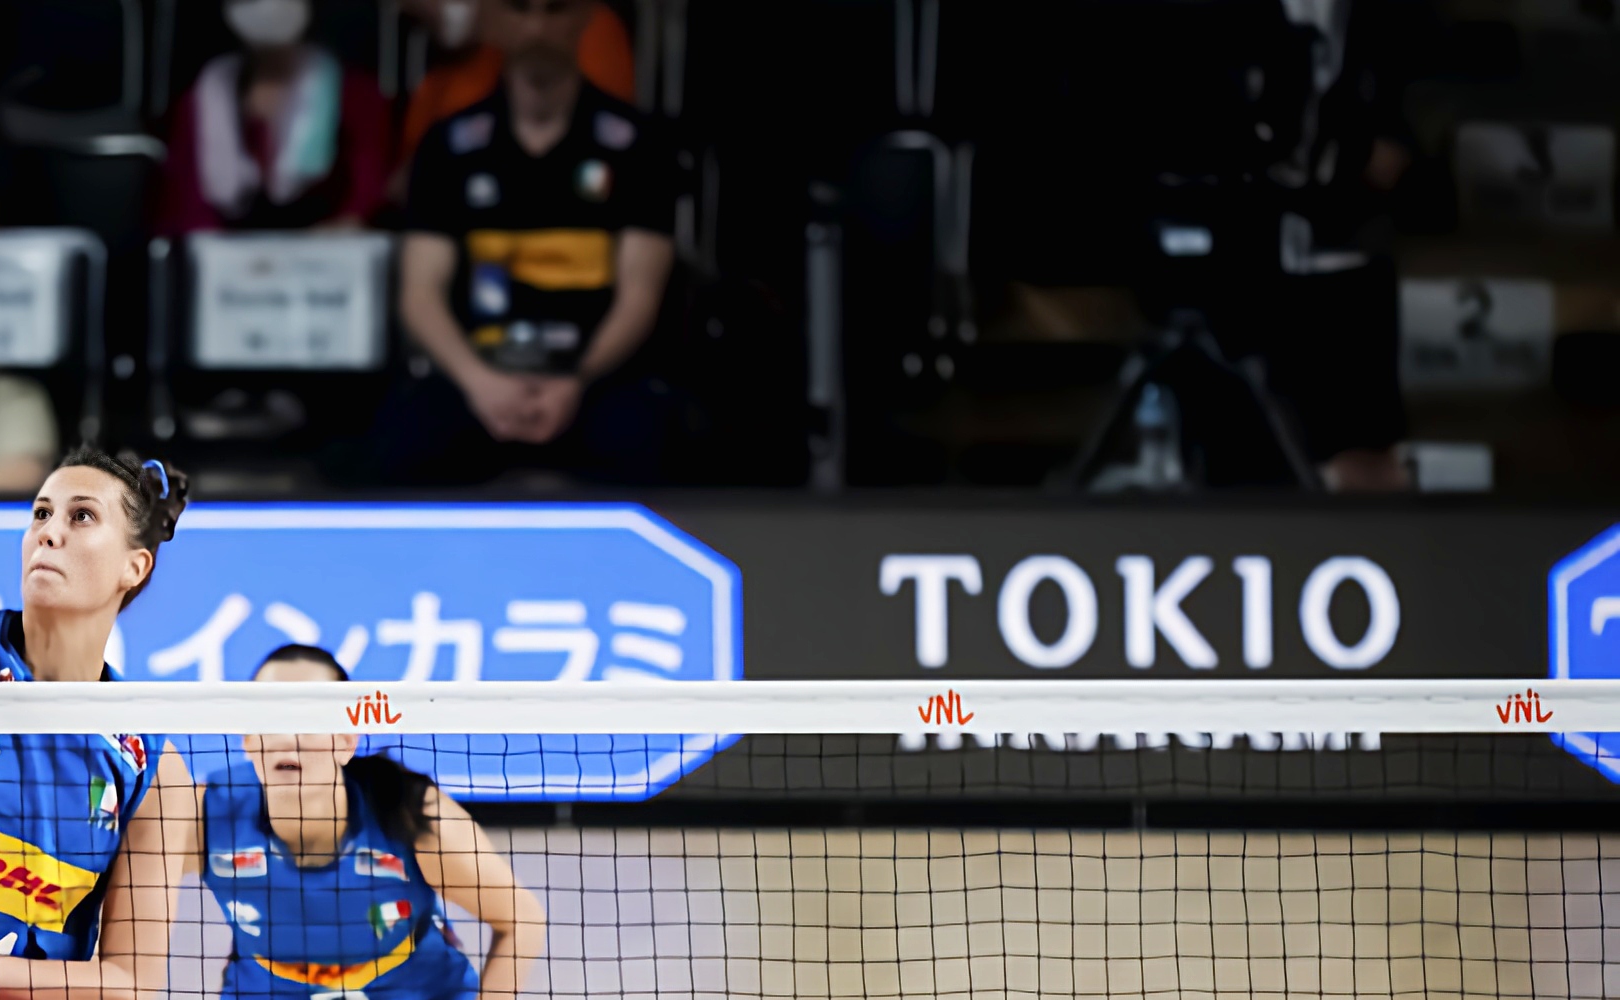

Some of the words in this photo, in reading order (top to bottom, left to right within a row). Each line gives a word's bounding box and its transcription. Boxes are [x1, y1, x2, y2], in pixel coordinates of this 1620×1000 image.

[879, 555, 1400, 669] TOKIO
[346, 690, 402, 727] VNL
[917, 689, 974, 726] VNL
[1495, 688, 1553, 725] VNL
